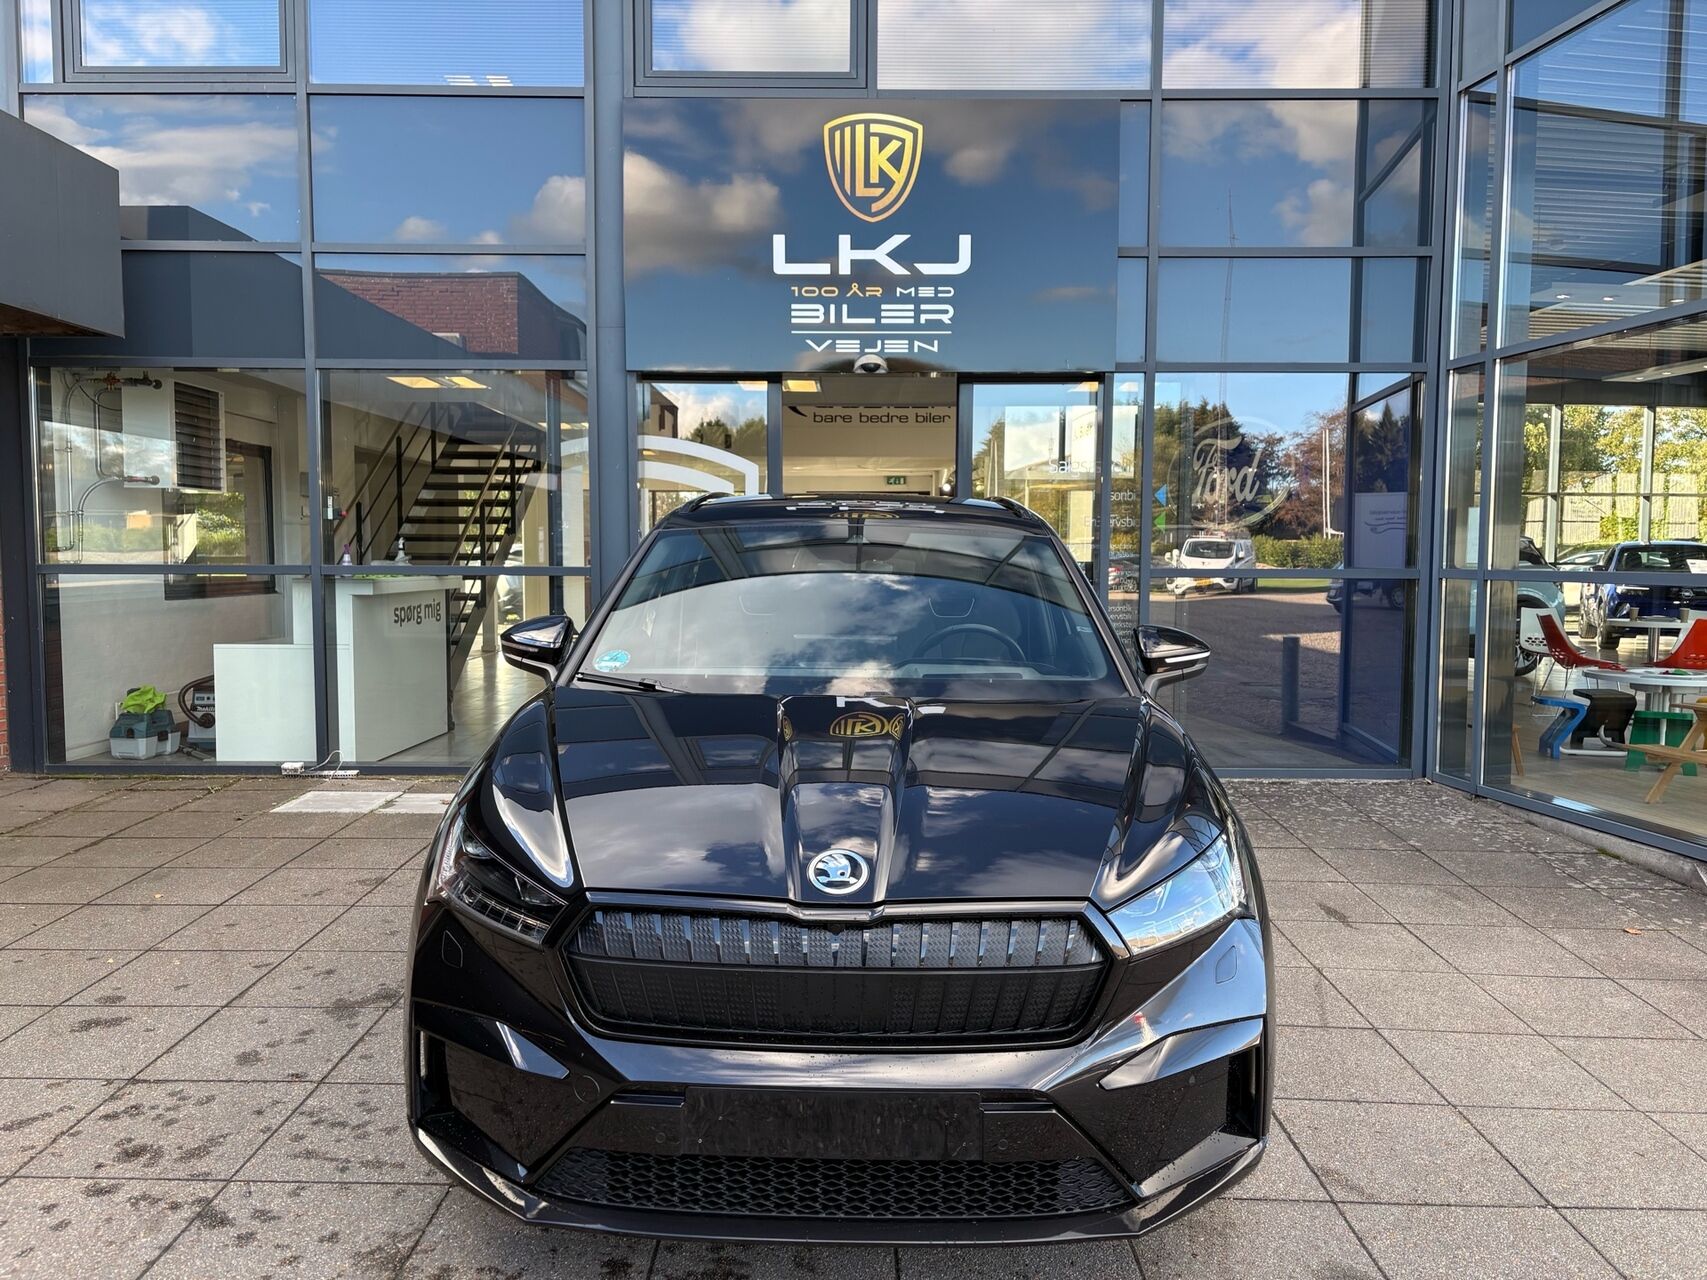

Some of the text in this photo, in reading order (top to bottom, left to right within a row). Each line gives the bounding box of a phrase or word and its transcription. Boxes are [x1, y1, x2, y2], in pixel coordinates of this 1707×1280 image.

[772, 234, 972, 275] LKJ
[790, 282, 955, 298] 100 ÅR MED
[790, 303, 955, 325] BILER
[804, 339, 939, 353] VEJEN
[813, 412, 951, 424] bare bedre biler
[1192, 435, 1262, 504] Ford
[393, 598, 442, 628] spørg mig
